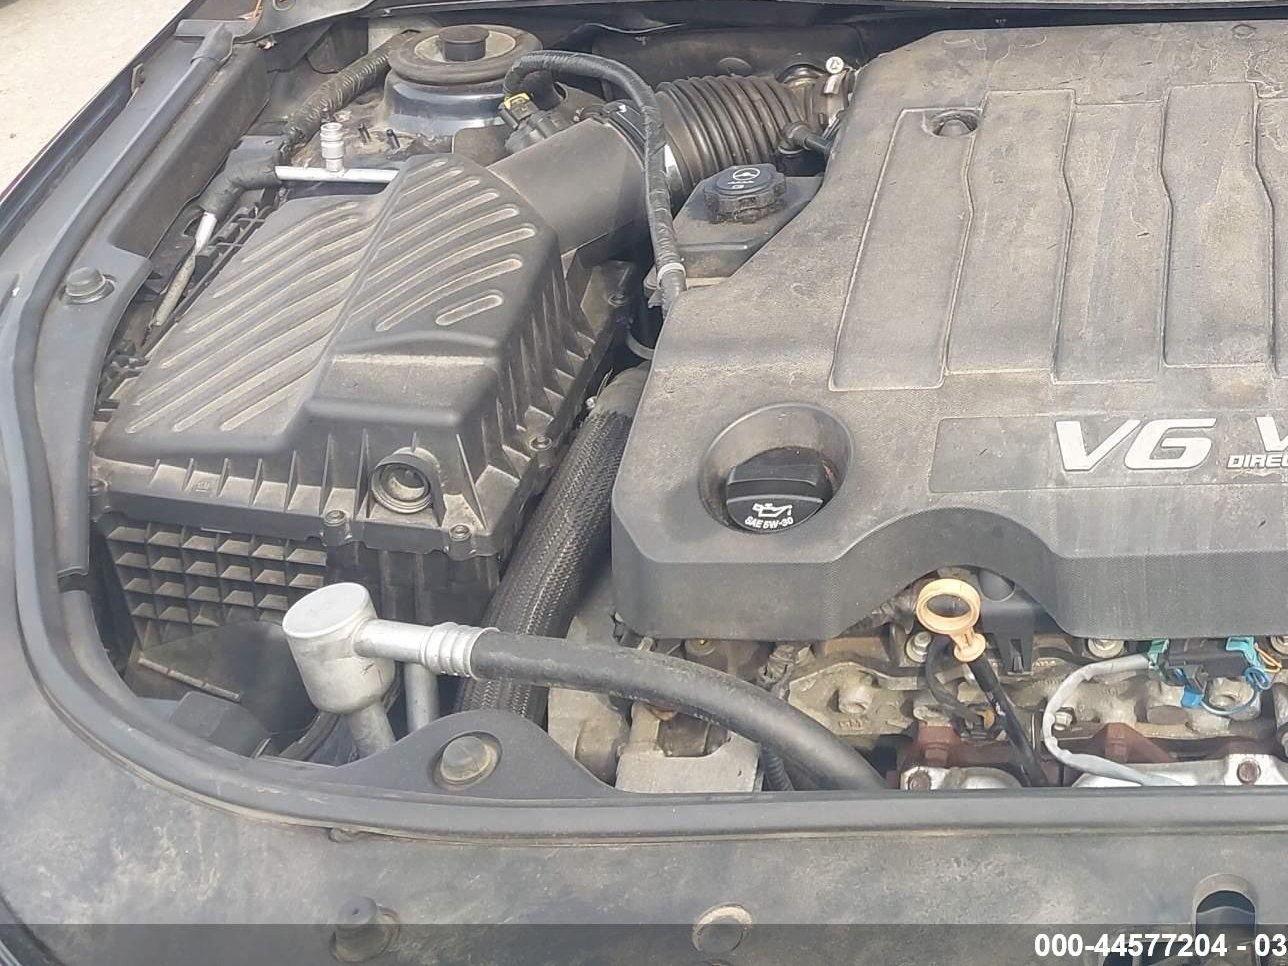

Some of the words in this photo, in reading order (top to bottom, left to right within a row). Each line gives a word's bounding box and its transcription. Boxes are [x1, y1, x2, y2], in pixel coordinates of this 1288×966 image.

[1054, 417, 1217, 471] V6
[745, 515, 763, 528] SAE
[763, 517, 794, 528] 5W-30
